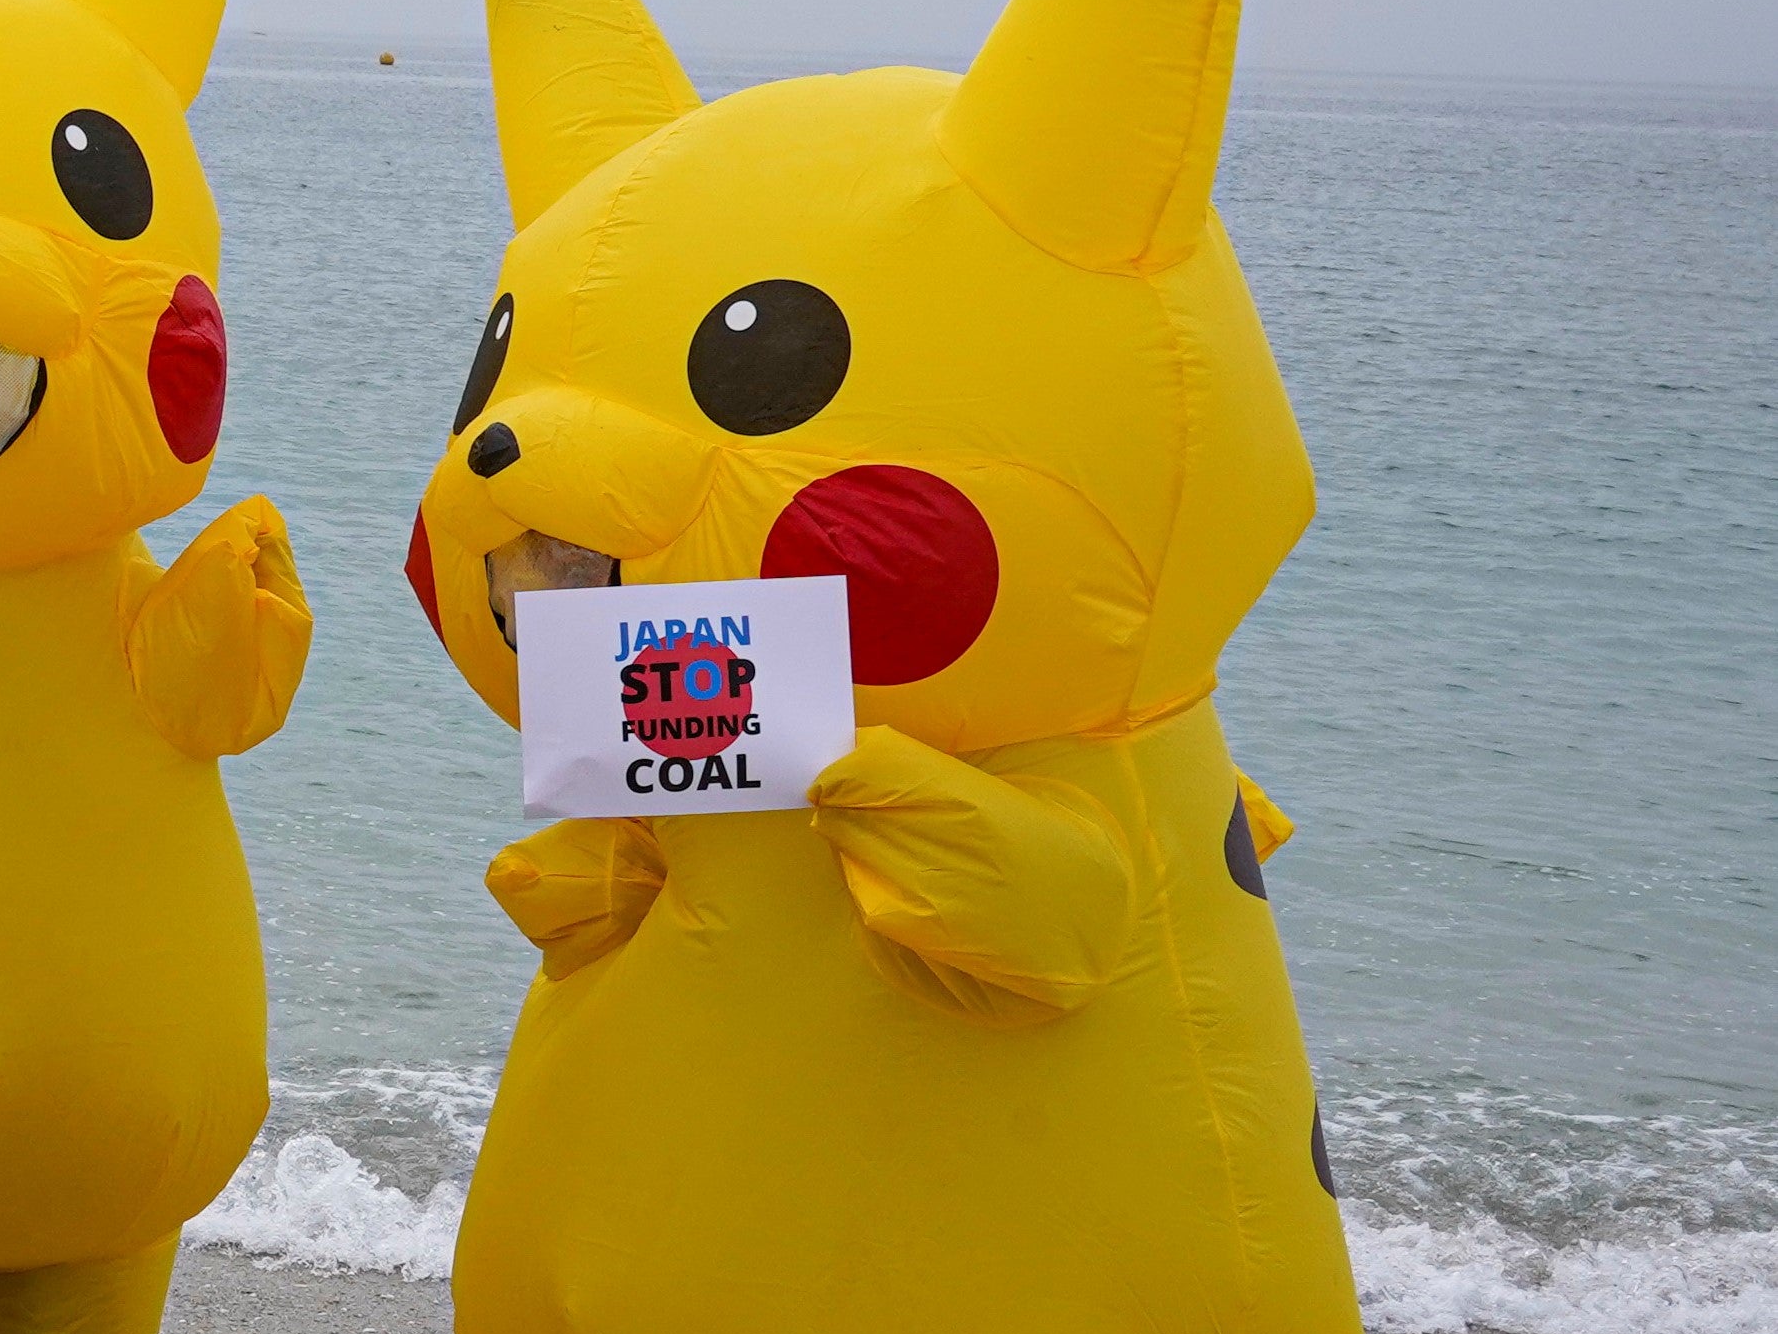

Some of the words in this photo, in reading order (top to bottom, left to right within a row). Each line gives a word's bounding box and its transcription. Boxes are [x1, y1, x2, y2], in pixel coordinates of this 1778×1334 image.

[615, 616, 751, 662] JAPAN
[620, 659, 756, 704] STOP
[622, 714, 761, 742] FUNDING
[626, 754, 761, 793] COAL
